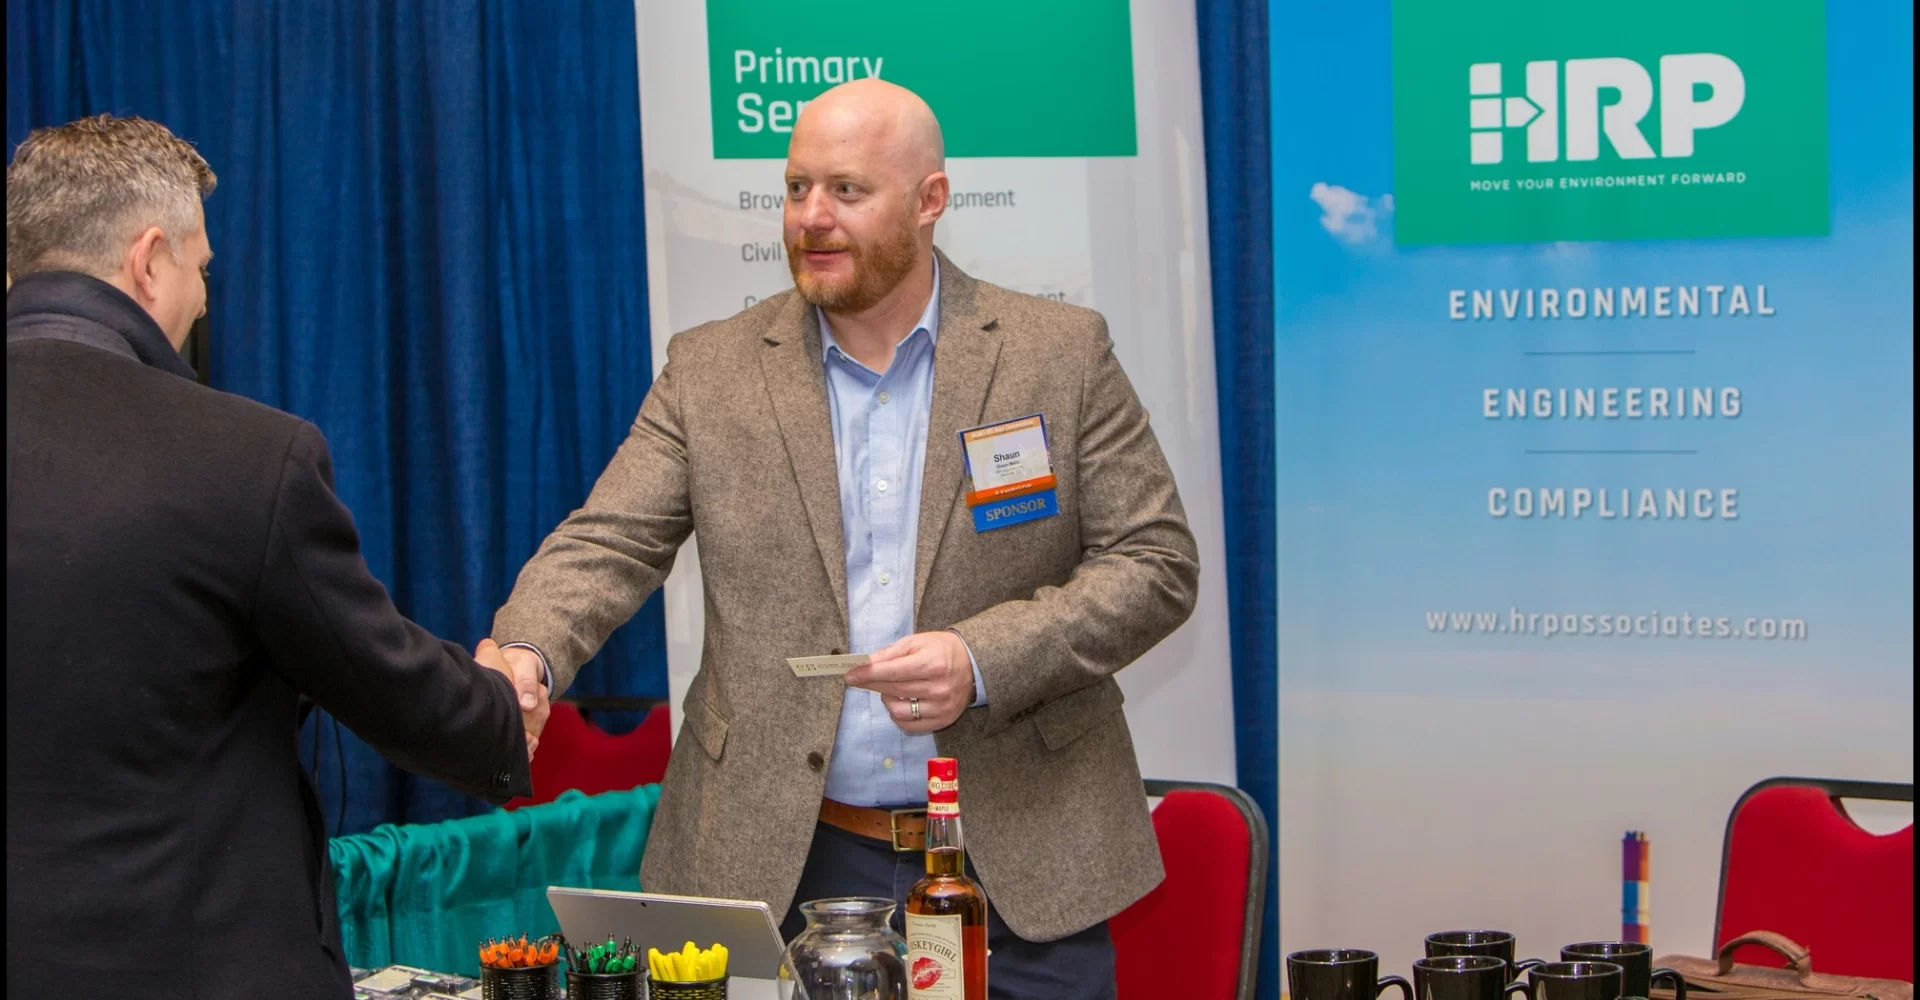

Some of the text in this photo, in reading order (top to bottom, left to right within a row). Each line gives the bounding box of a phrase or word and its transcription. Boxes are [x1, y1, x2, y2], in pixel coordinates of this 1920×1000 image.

[734, 47, 883, 83] Primary
[1470, 53, 1746, 165] HRP
[1471, 171, 1746, 192] MOVE YOUR ENVIRONMENT FORWARD
[742, 242, 781, 262] Civil
[1448, 285, 1776, 320] ENVIRONMENTAL
[1482, 386, 1742, 418] ENGINEERING
[993, 451, 1020, 462] Shaun
[985, 498, 1046, 521] SPONSOR
[1488, 487, 1739, 519] COMPLIANCE
[1426, 607, 1807, 639] www.hrpassociates.com
